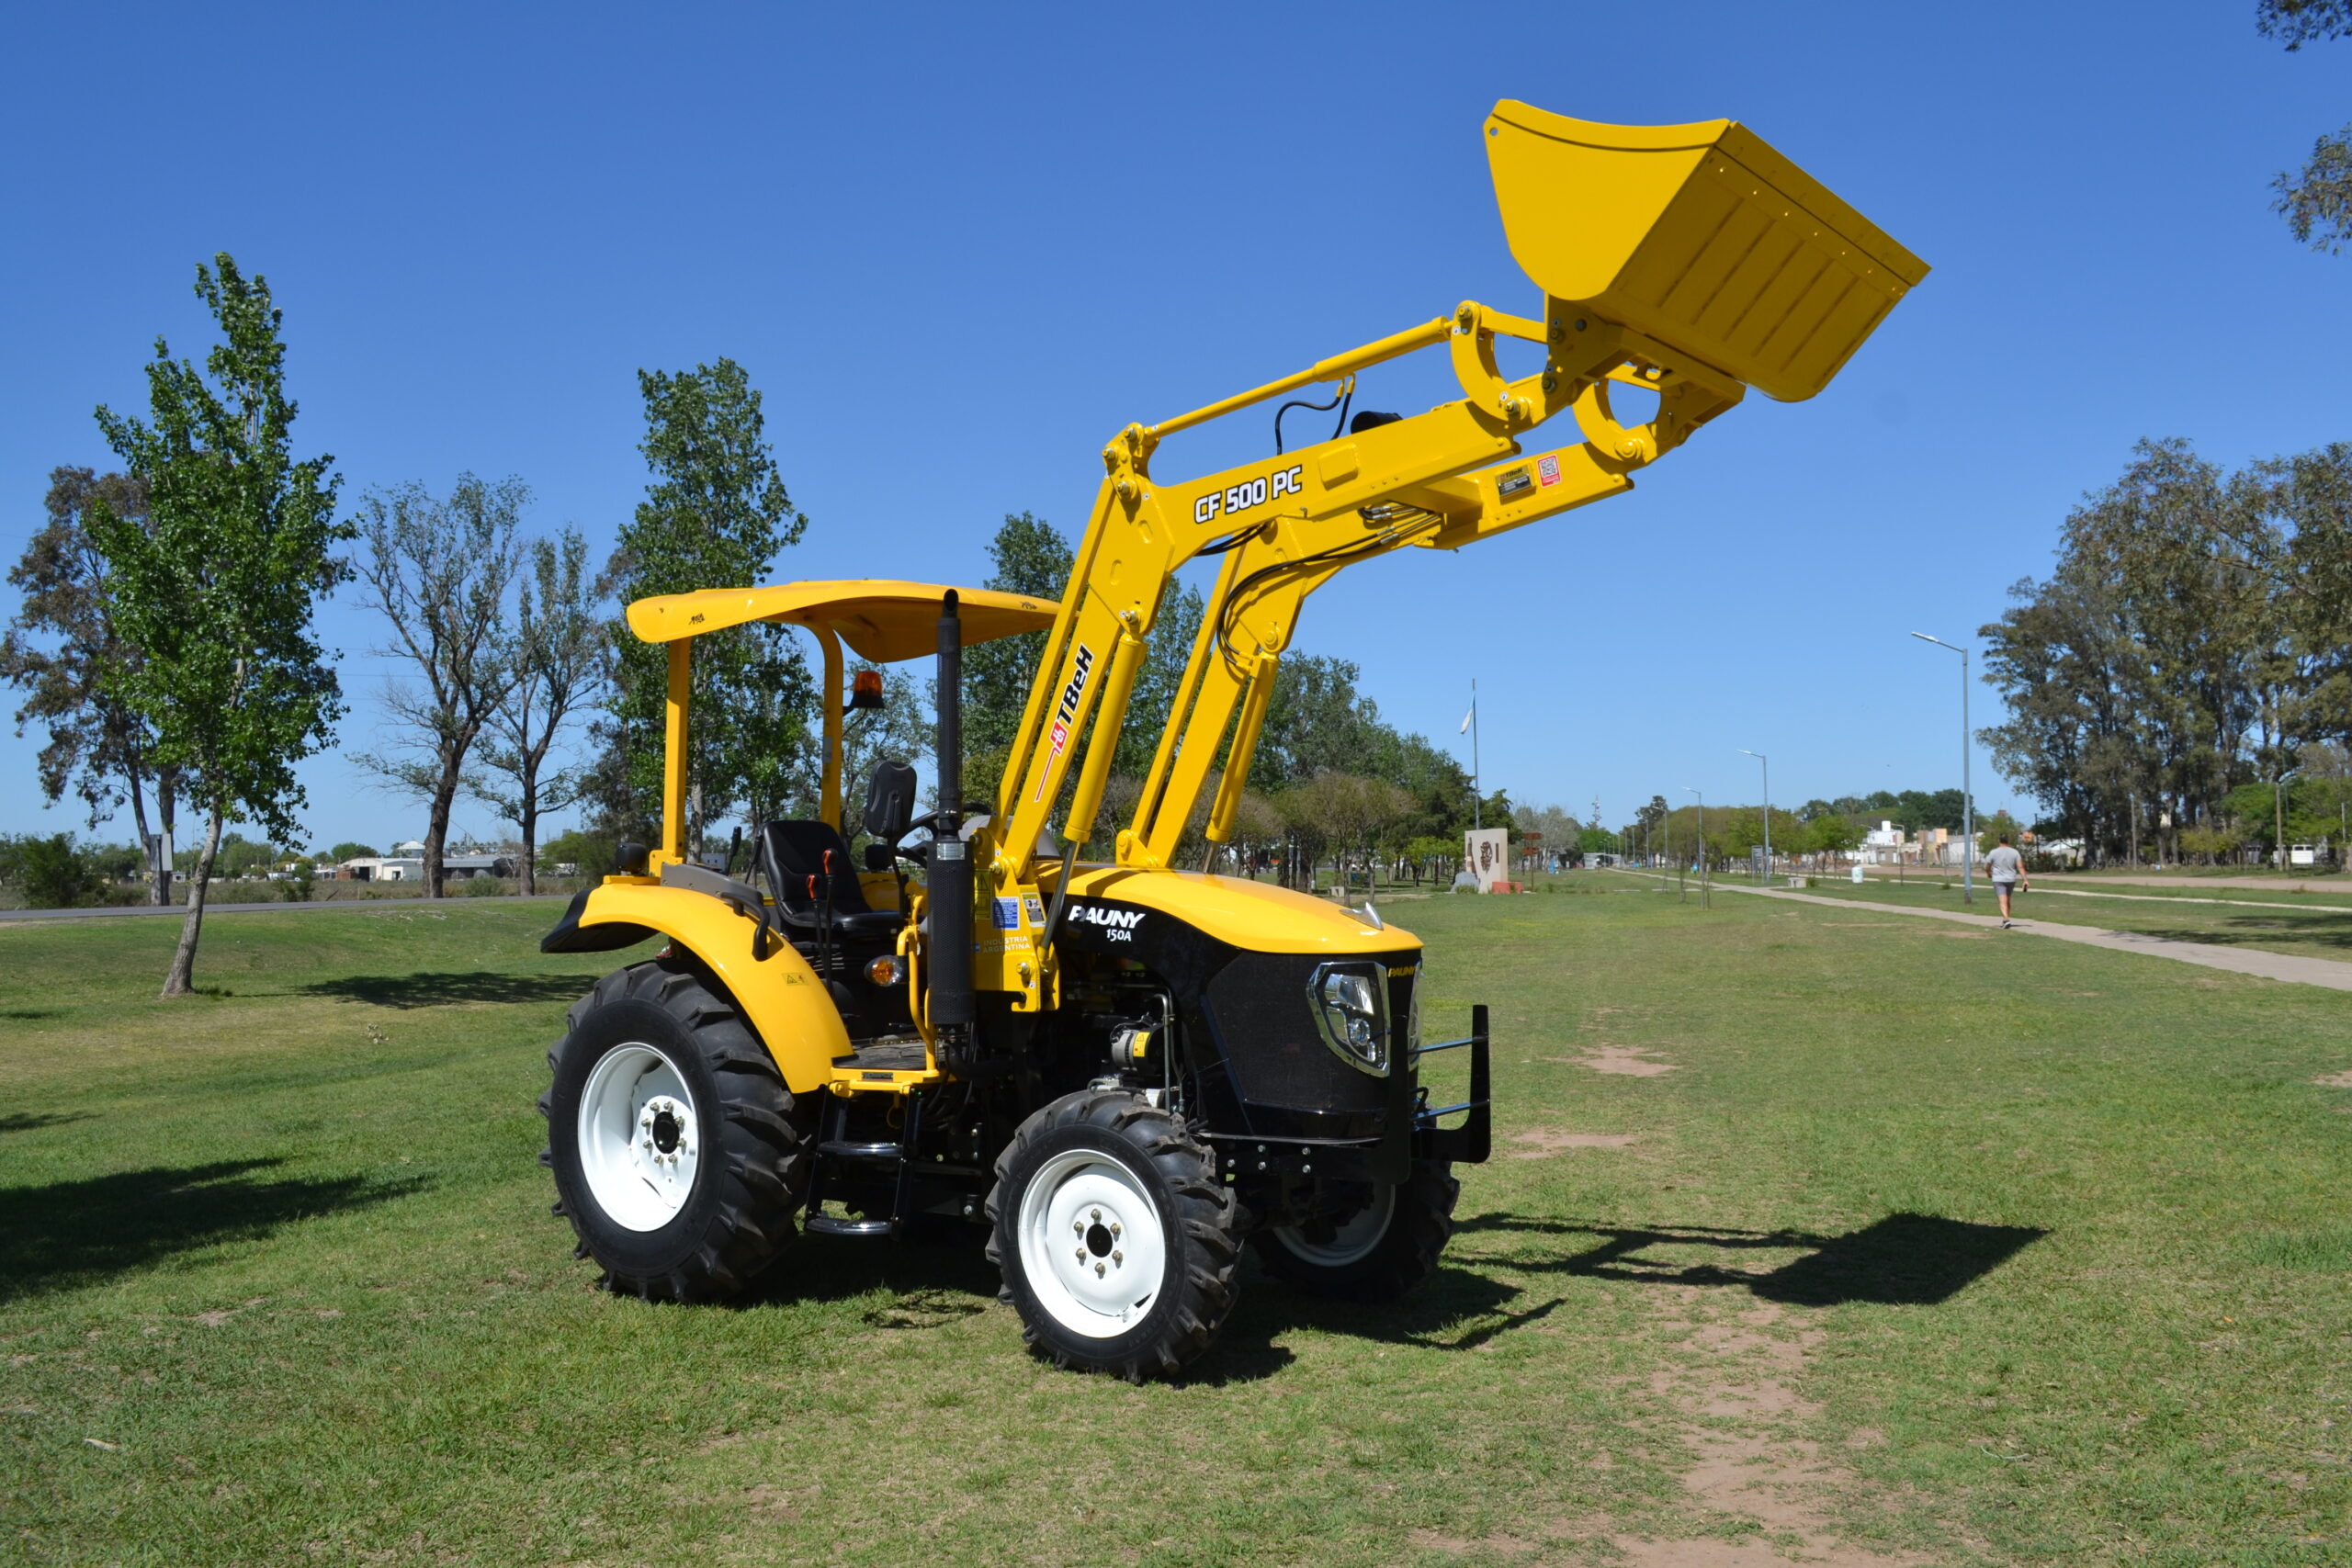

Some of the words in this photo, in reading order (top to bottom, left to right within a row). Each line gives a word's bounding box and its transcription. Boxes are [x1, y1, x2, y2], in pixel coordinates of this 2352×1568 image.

[1194, 491, 1222, 525] CF
[1225, 477, 1267, 514] 500
[1272, 464, 1303, 500] PC
[1057, 643, 1094, 726] TBeH
[1068, 905, 1146, 929] PAUNY
[983, 936, 1027, 945] INDUSTRIA
[1106, 929, 1132, 942] 150A
[983, 943, 1030, 953] ARGENTINA
